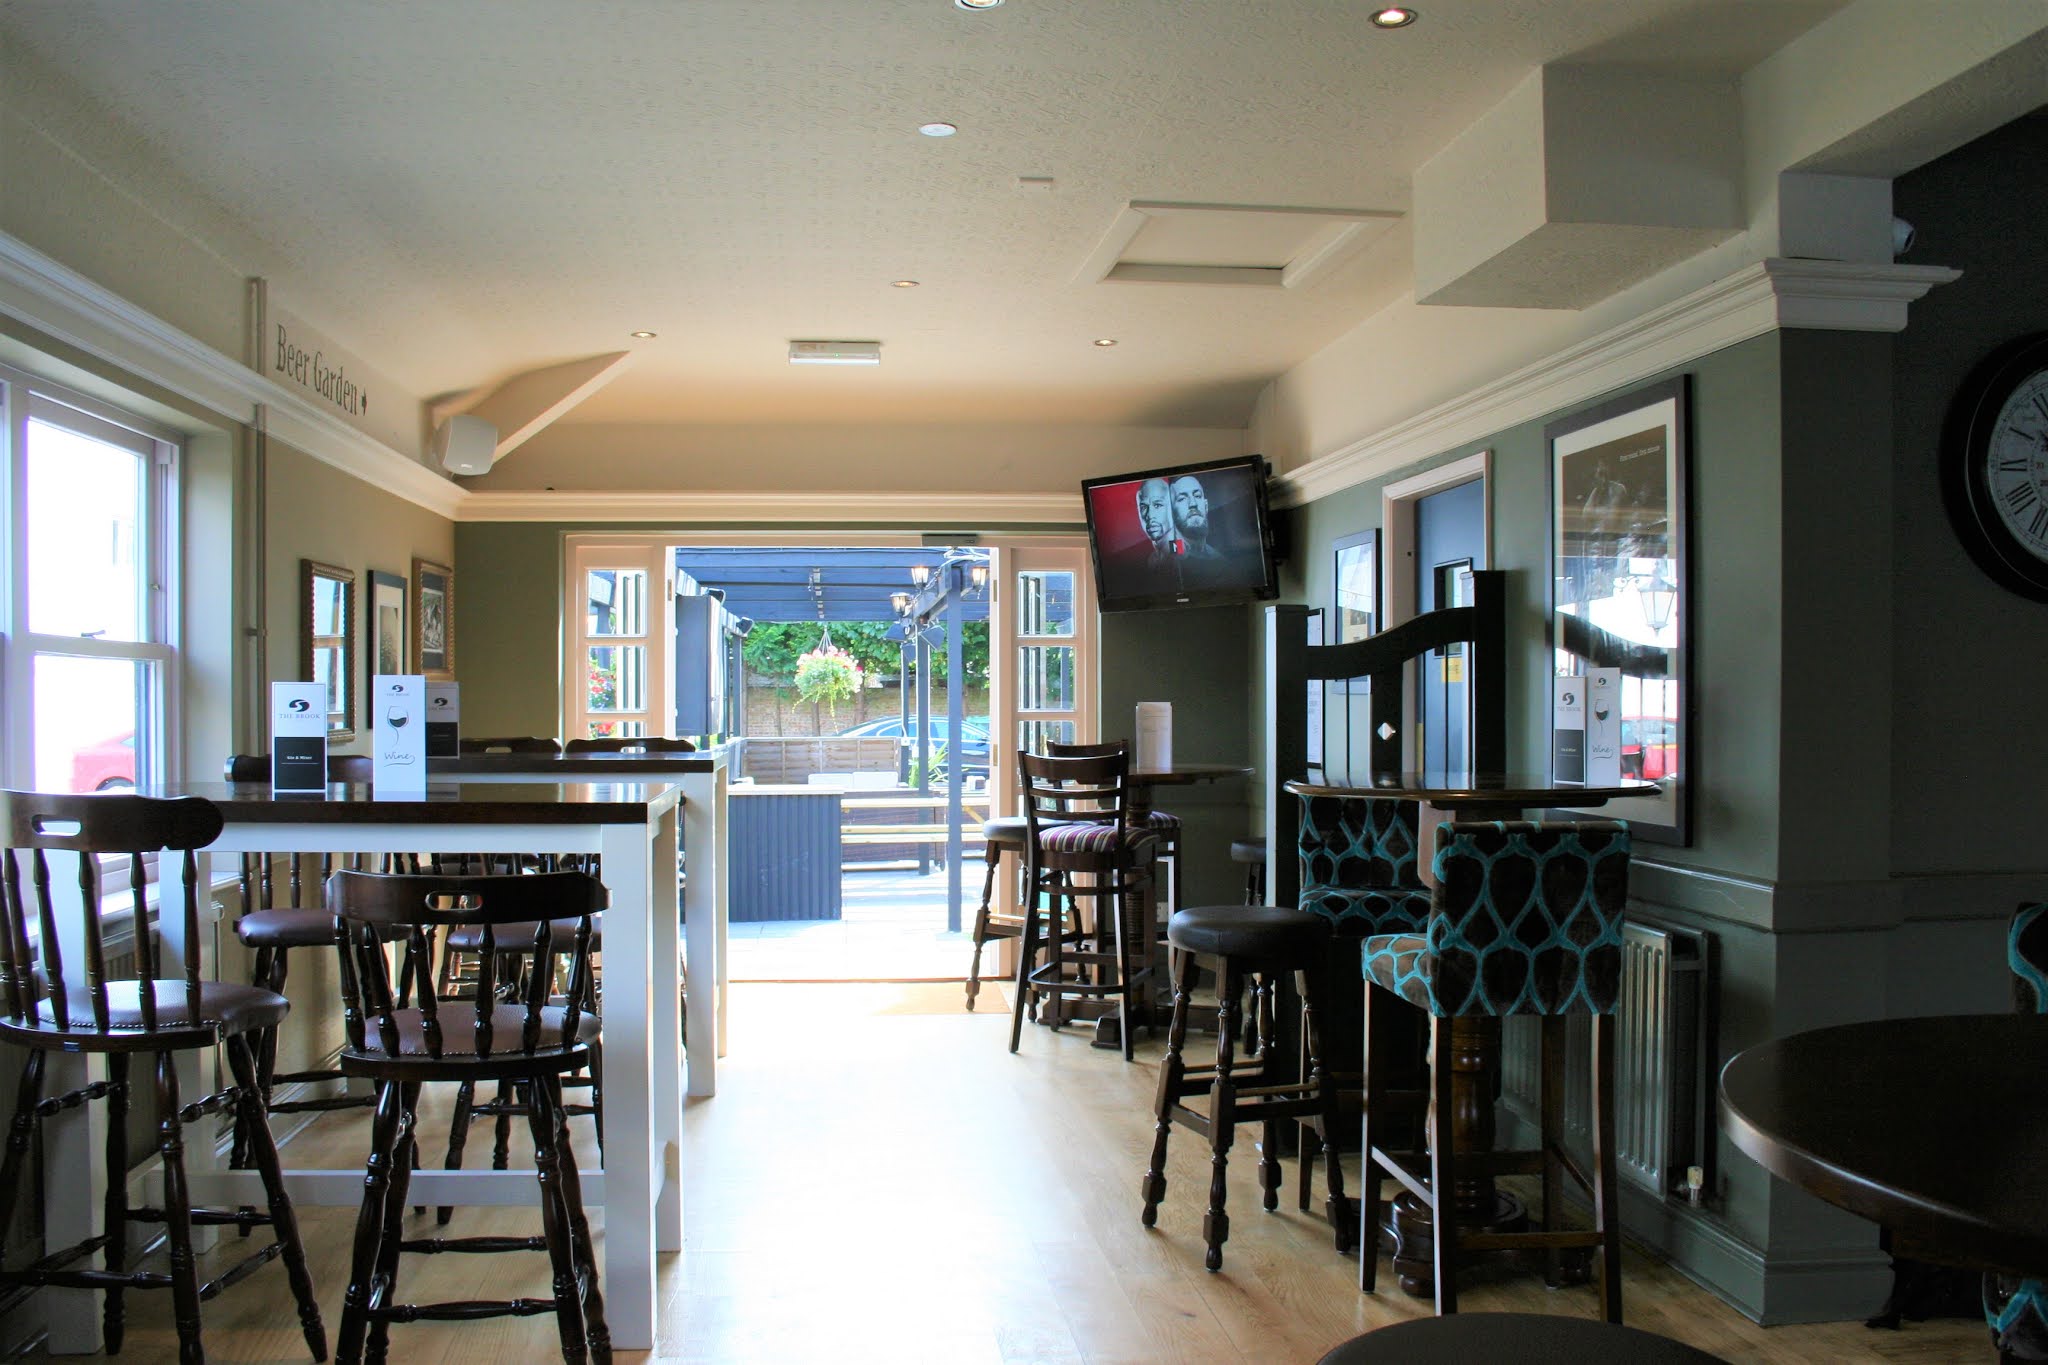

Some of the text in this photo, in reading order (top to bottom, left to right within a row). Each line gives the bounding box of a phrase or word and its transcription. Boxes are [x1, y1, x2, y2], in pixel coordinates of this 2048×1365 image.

[276, 323, 358, 416] Beer Garden
[384, 751, 415, 762] Wine
